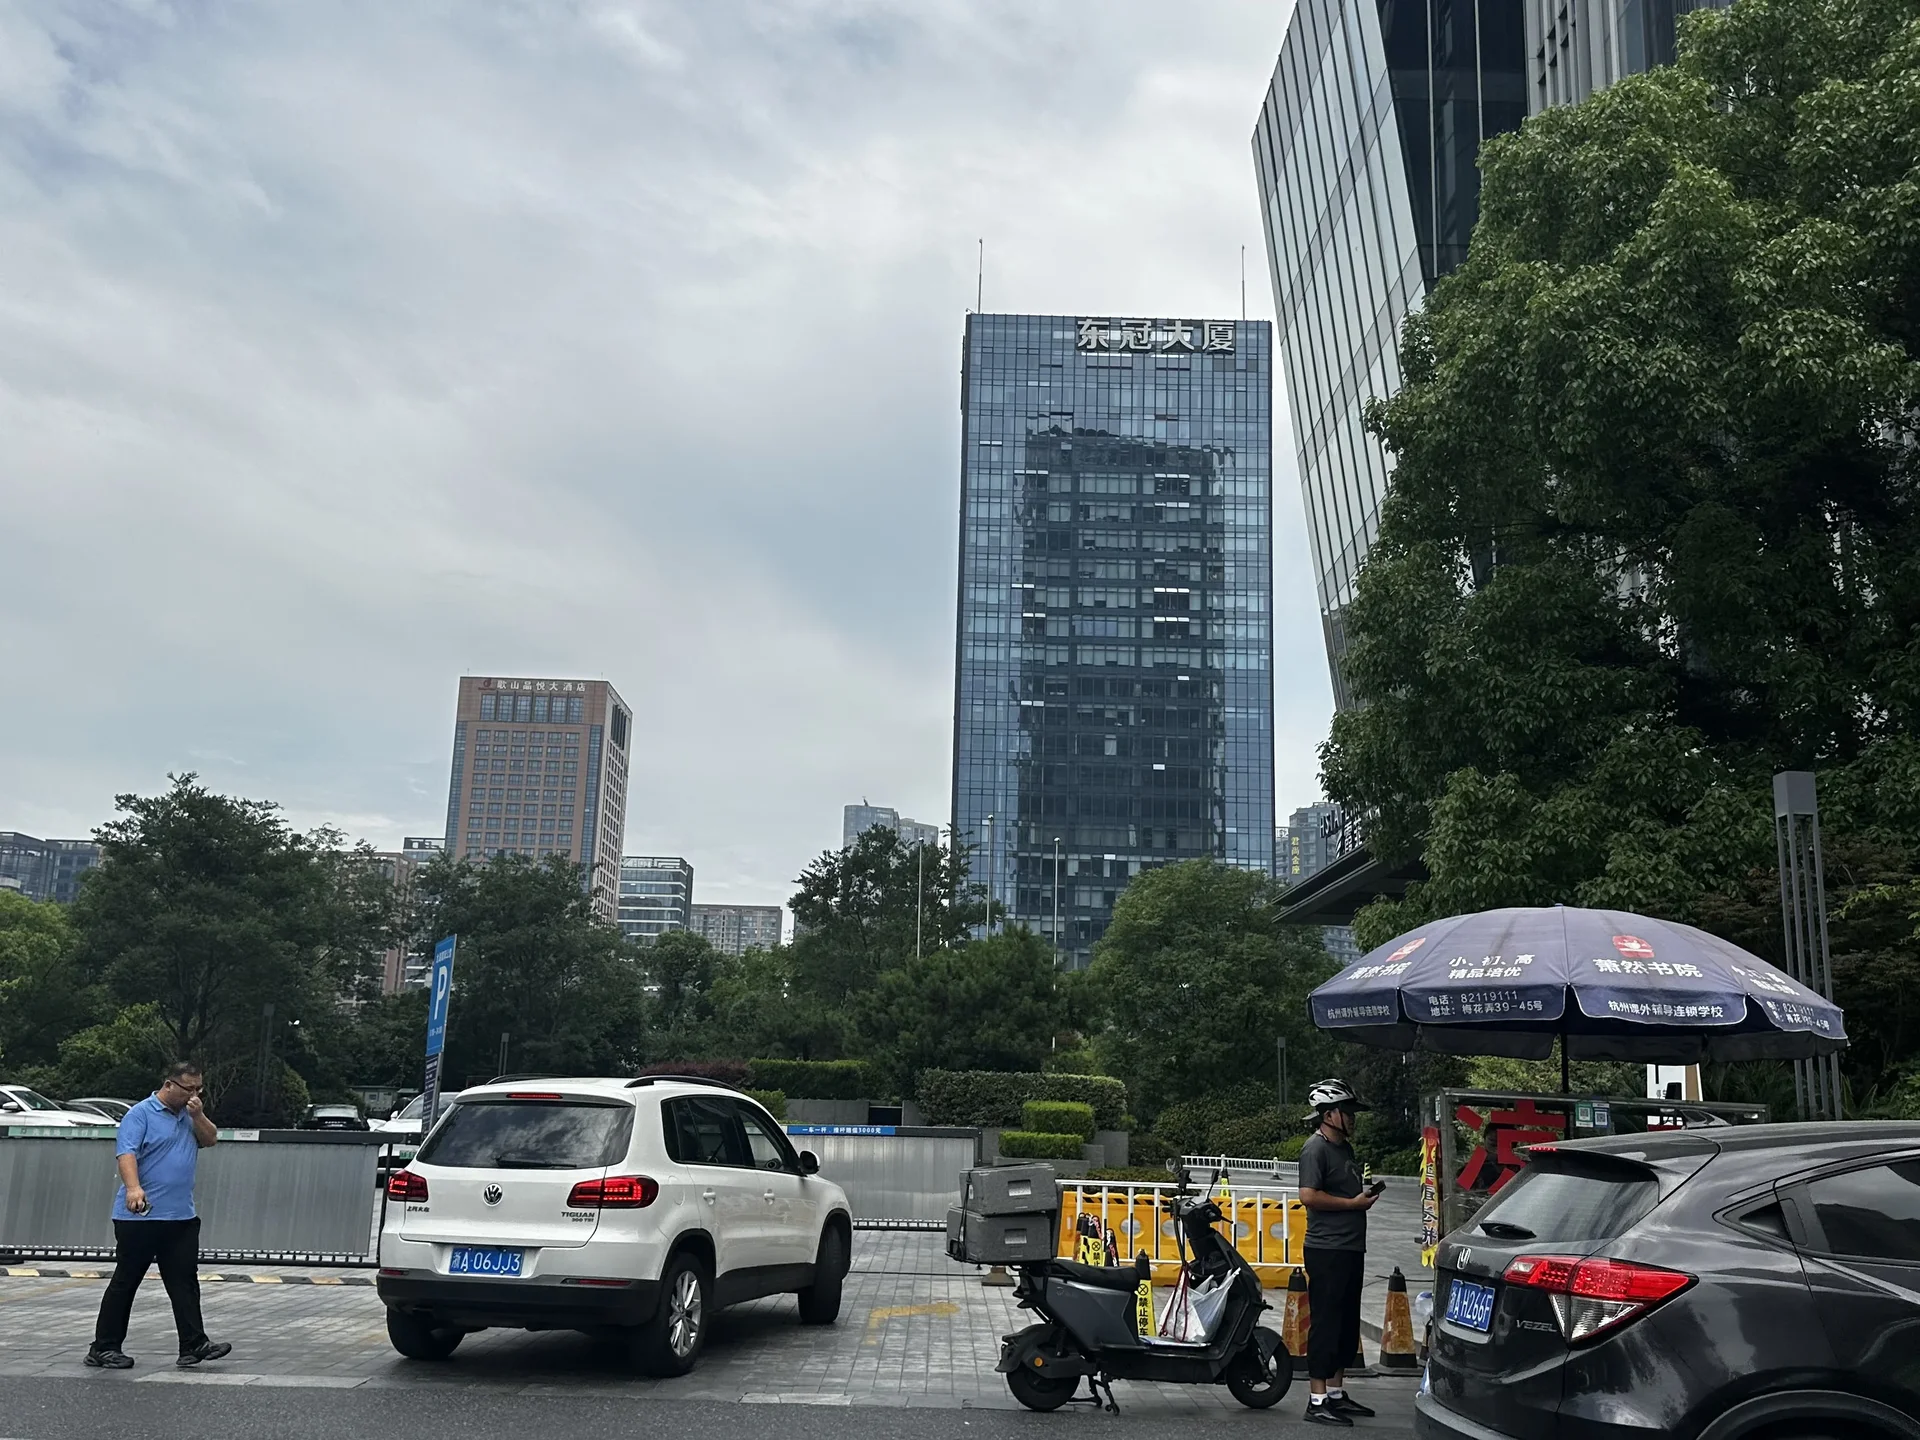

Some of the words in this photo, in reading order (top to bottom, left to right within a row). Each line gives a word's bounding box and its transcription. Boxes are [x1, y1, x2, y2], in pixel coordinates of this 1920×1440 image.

[1077, 318, 1235, 351] 东冠大厦
[496, 681, 586, 692] 歌山品悦大酒店
[1291, 836, 1300, 875] 君尚金座
[1448, 967, 1522, 979] 精品培优
[1593, 958, 1703, 978] 萧然书院
[434, 965, 448, 1020] P
[1460, 990, 1518, 1003] 82119111
[1608, 1000, 1723, 1018] 杭州课外辅导连锁学校
[1138, 1297, 1149, 1336] 禁止停车
[1516, 1319, 1558, 1333] VEZEL
